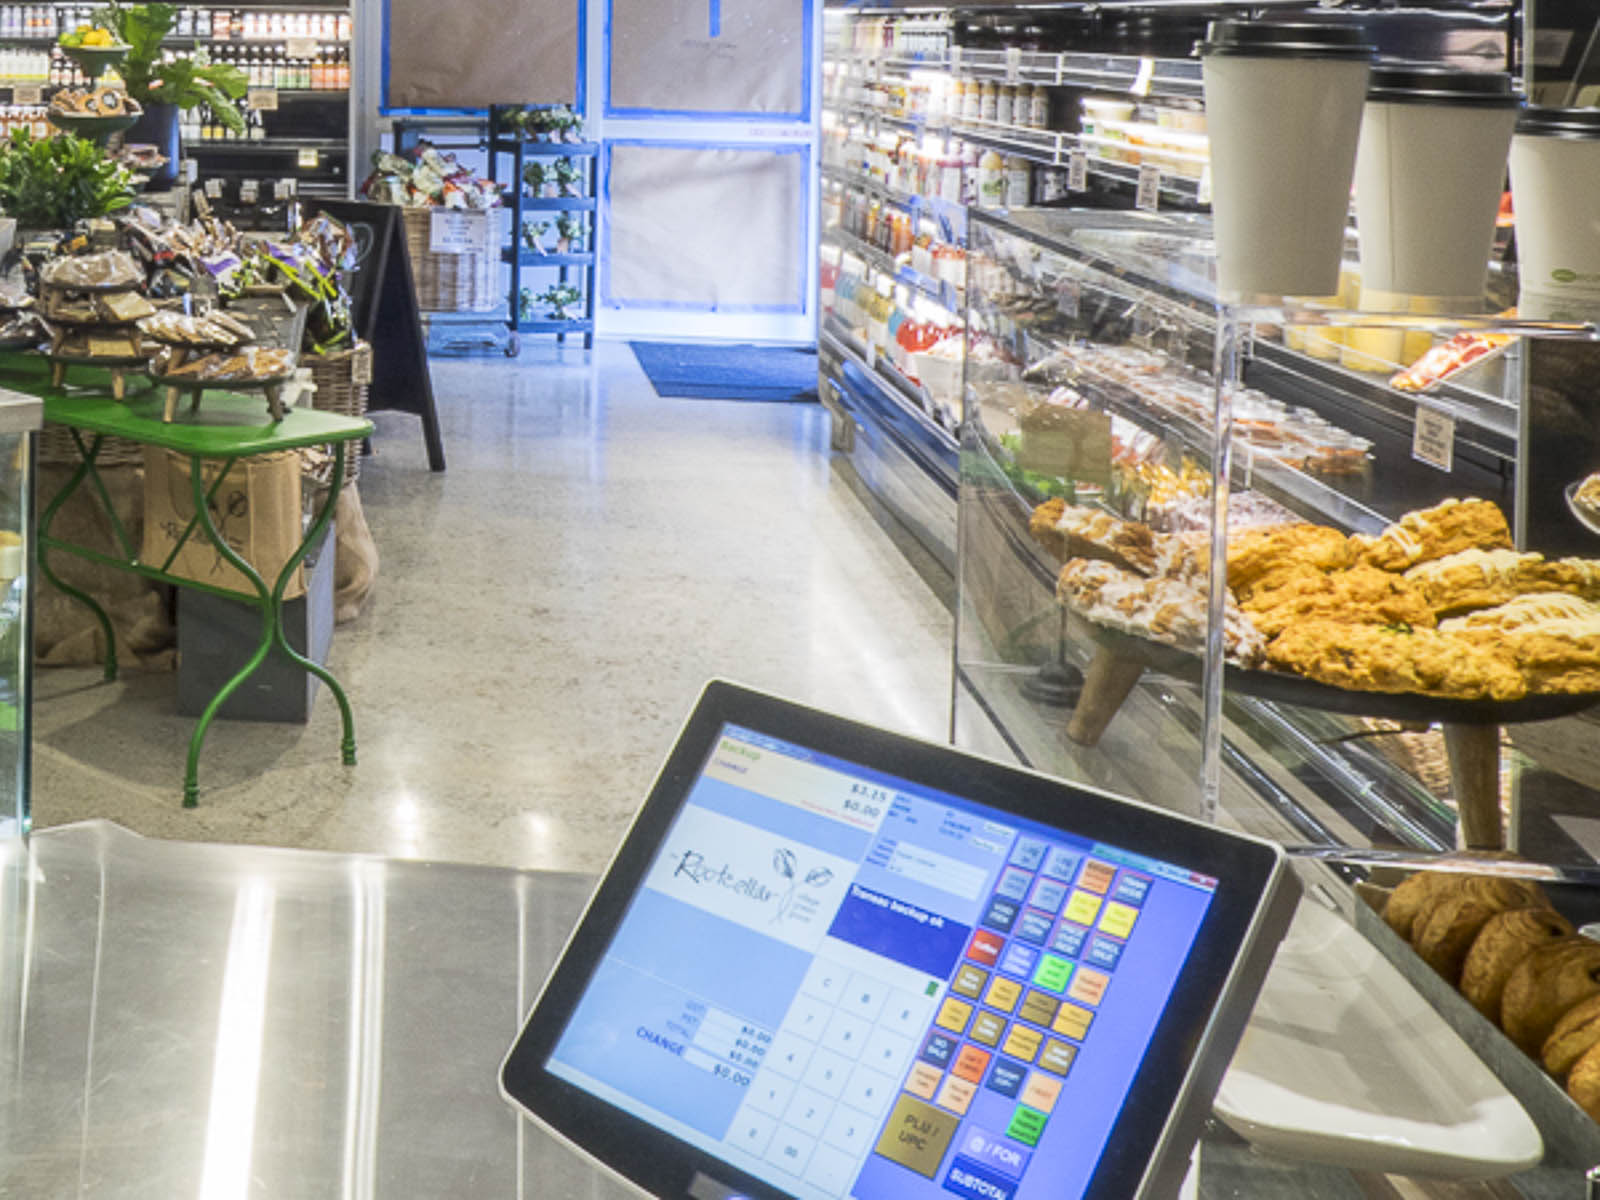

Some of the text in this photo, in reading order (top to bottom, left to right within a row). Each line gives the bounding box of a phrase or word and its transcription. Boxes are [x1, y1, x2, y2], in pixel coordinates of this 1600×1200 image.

[635, 1025, 685, 1056] CHANGE
[898, 1130, 928, 1151] UPC
[992, 1143, 1022, 1167] FOR
